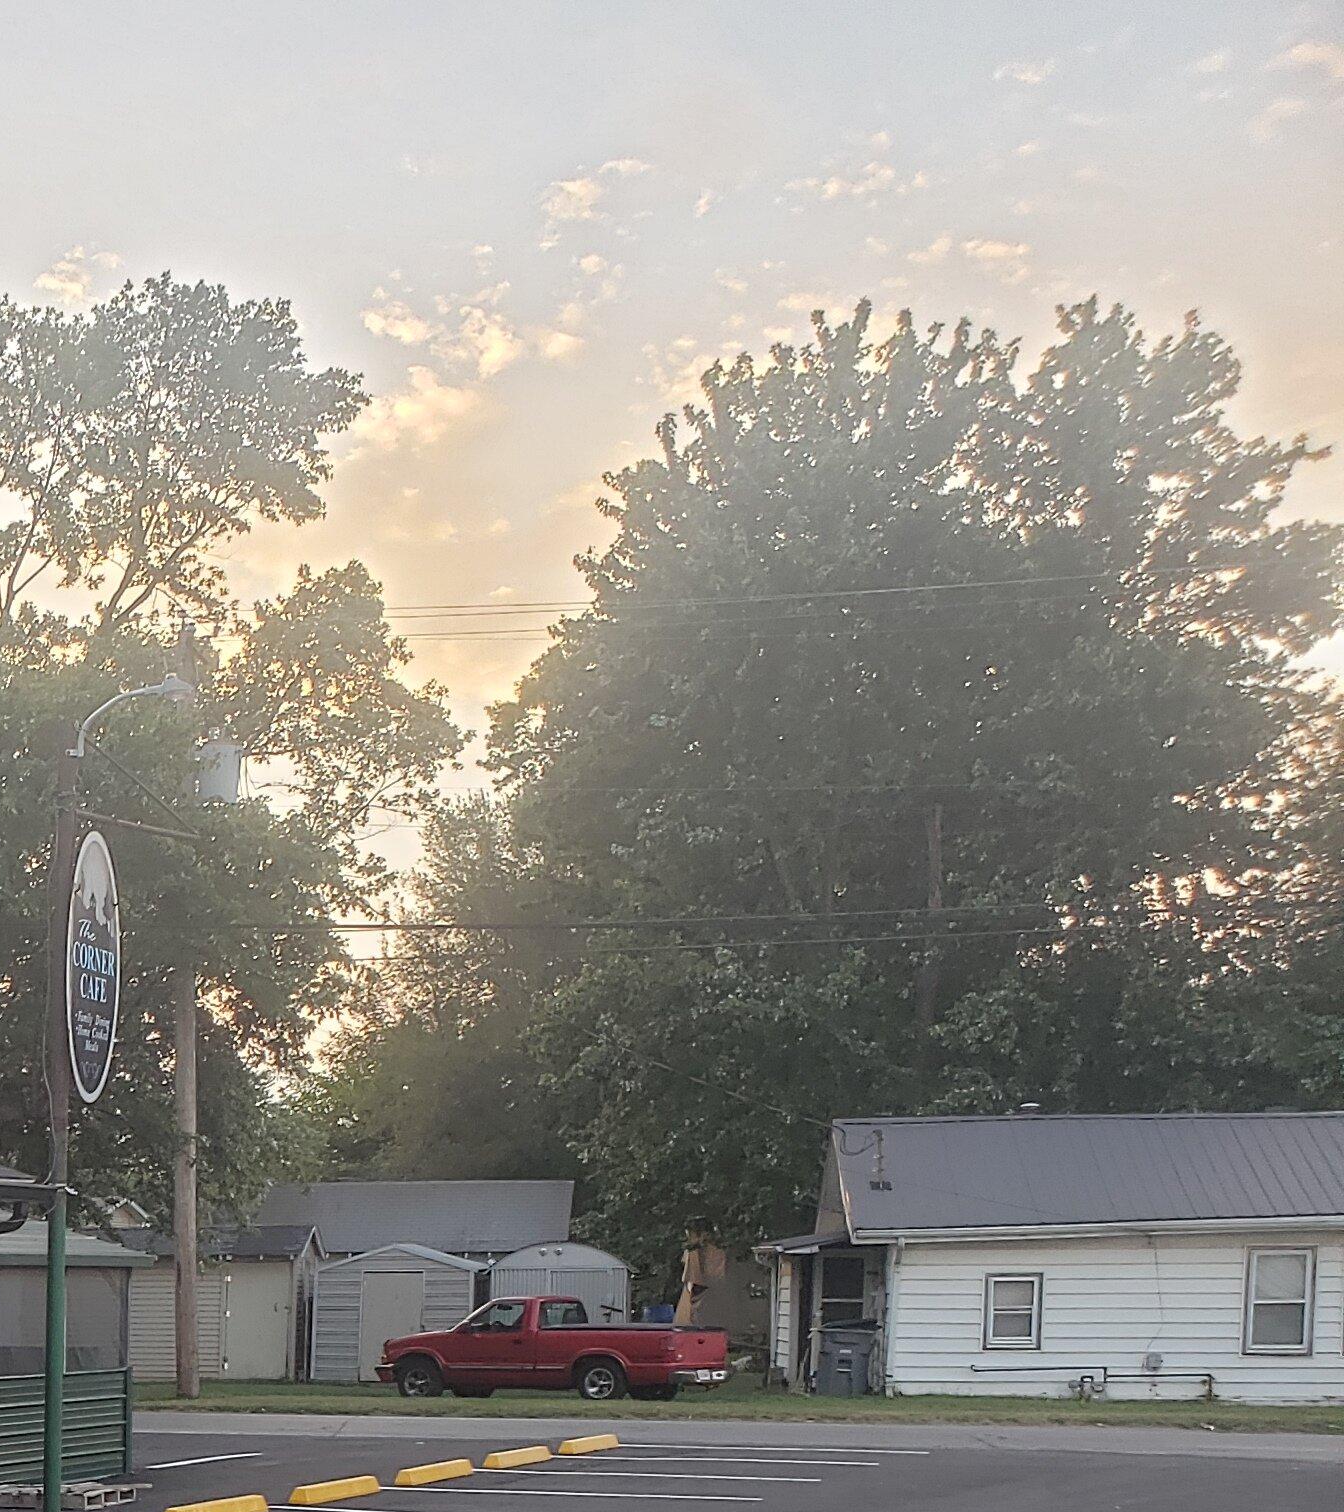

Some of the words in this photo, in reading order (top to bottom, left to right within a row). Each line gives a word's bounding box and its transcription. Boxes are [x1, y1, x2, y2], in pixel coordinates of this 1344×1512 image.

[78, 918, 97, 942] The
[72, 940, 115, 977] CORNER
[80, 972, 108, 1003] CAFE
